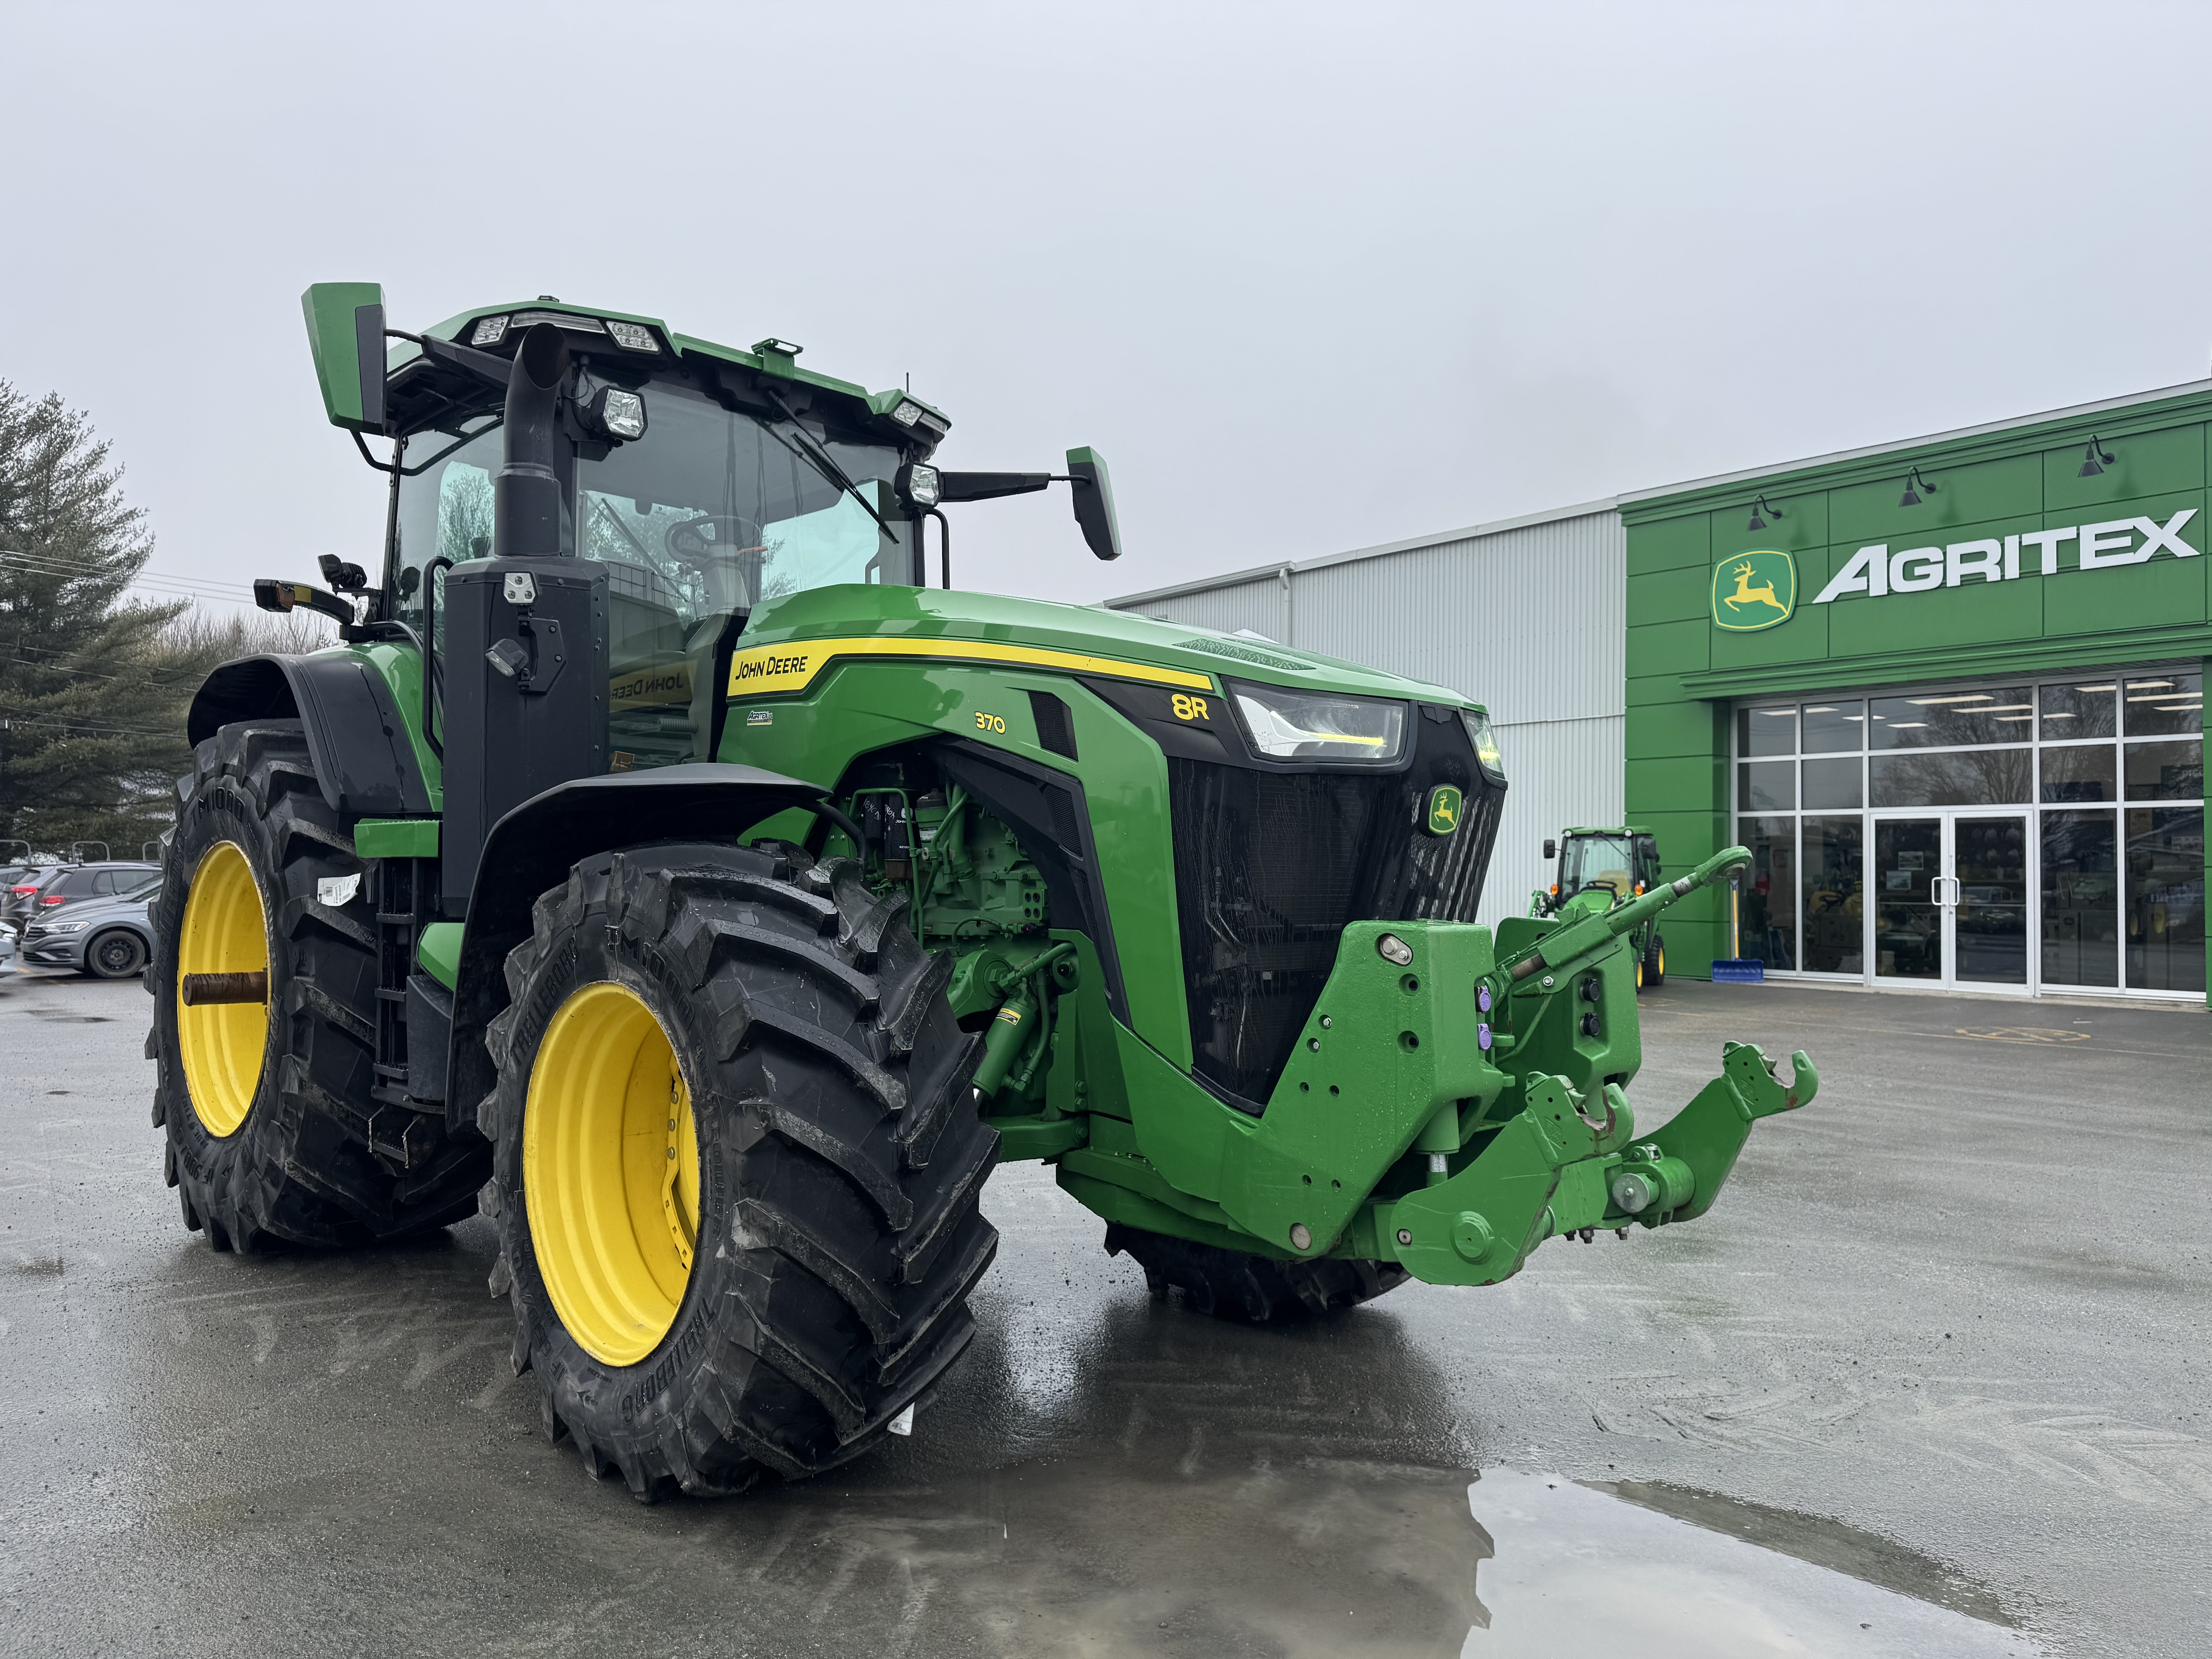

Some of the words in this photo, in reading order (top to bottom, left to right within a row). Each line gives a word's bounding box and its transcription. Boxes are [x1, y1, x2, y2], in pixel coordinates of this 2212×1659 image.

[1812, 508, 2200, 604] AGRITEX
[735, 661, 765, 680] JOHN
[766, 656, 809, 676] DEERE
[1171, 694, 1210, 720] 8R
[975, 711, 1006, 734] 370
[510, 936, 579, 1066] TRELLEBORG
[549, 1360, 568, 1385] IF
[621, 1297, 717, 1425] TRELLEBORG
